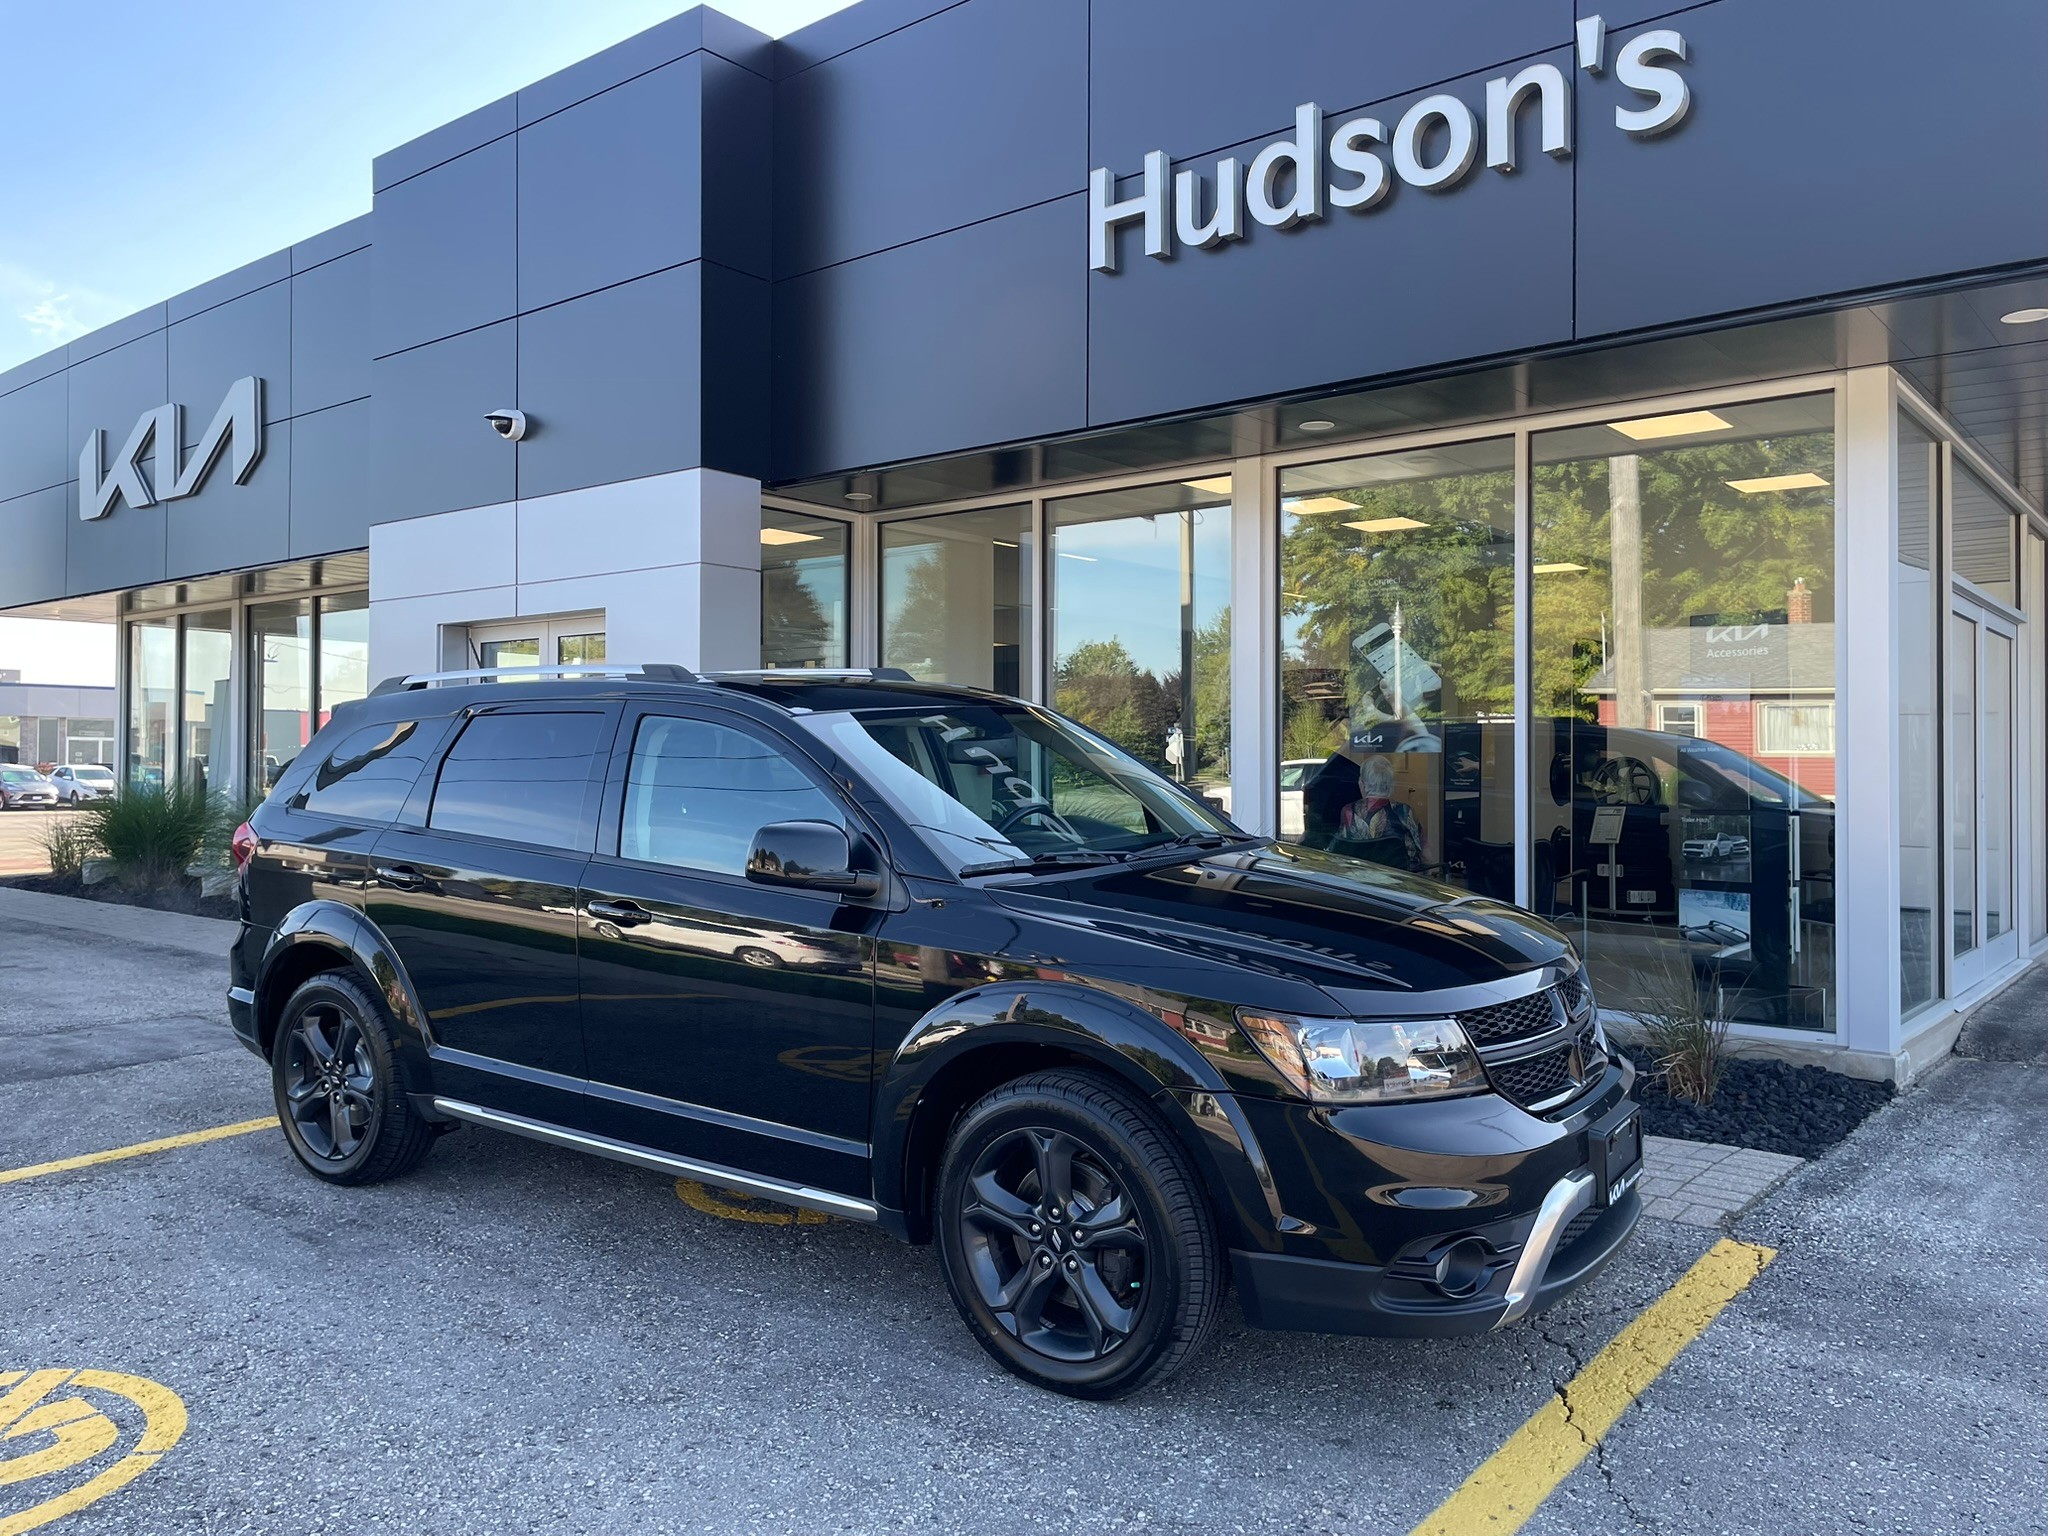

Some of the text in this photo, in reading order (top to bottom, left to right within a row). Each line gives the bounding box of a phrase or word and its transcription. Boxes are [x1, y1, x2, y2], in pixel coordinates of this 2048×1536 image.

[1089, 14, 1691, 274] Hudson's
[79, 376, 261, 521] KIA
[1706, 623, 1768, 643] KIA
[1706, 645, 1769, 658] Accessories
[1353, 734, 1383, 744] KIA
